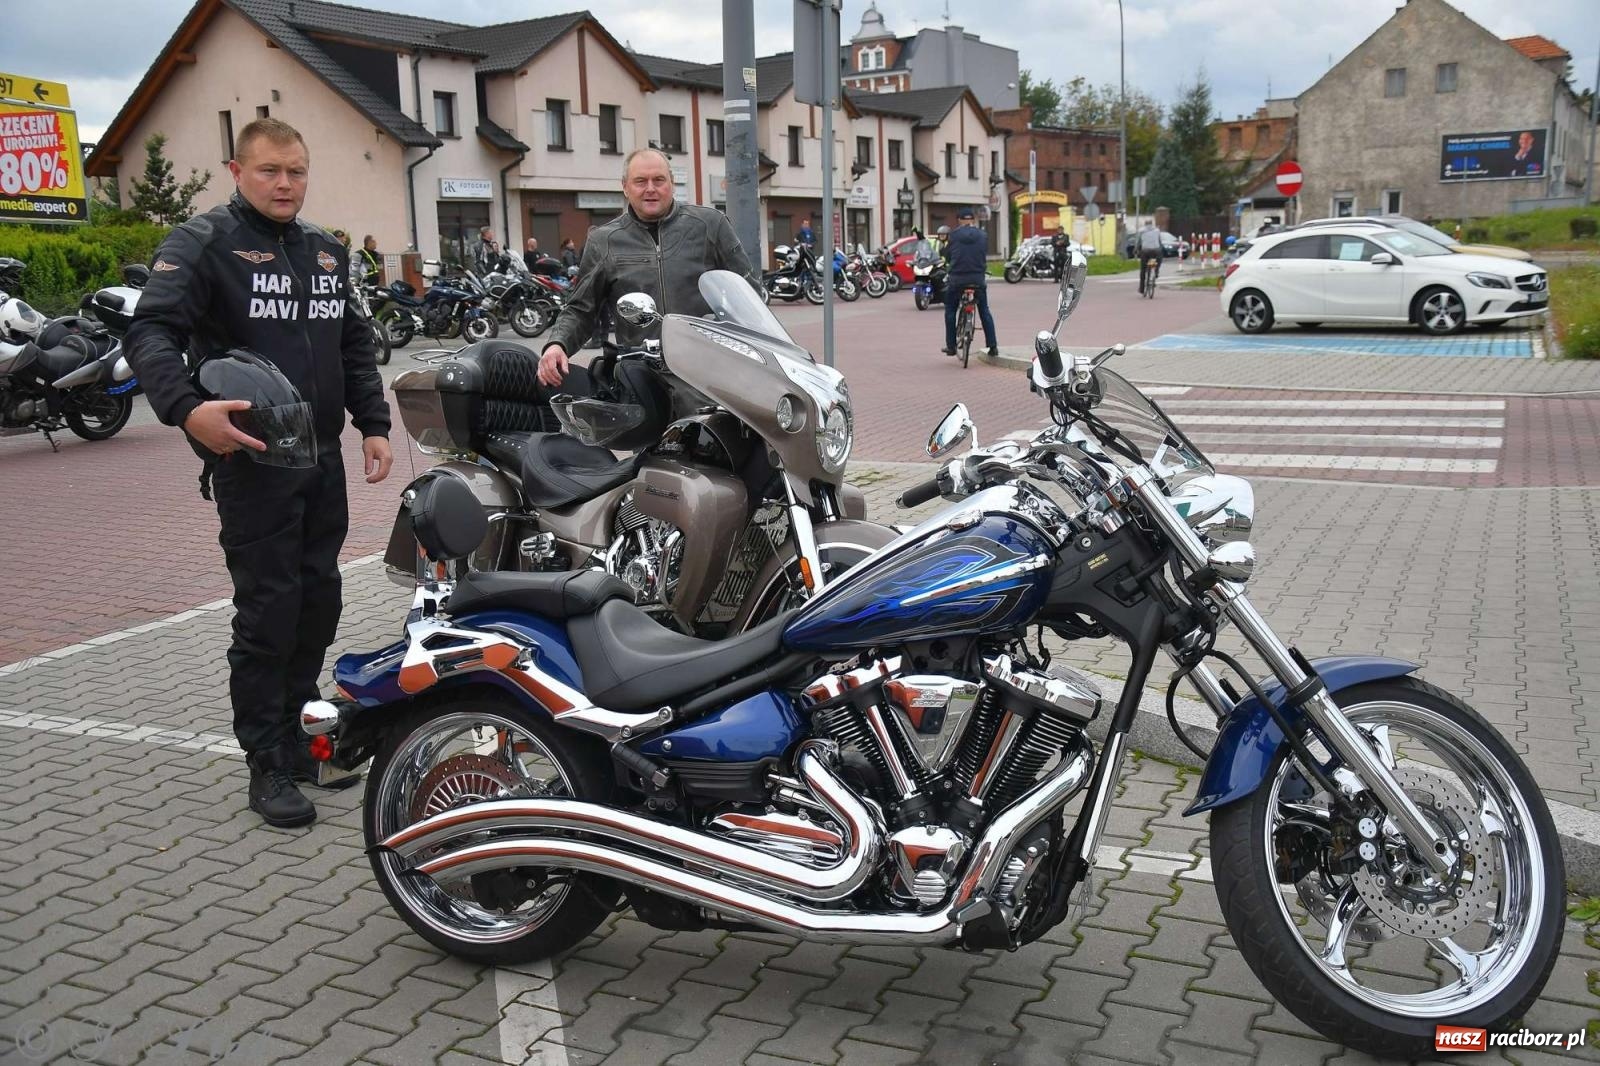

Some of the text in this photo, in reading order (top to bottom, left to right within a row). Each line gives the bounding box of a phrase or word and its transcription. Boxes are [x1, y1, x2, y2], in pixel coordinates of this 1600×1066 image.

[4, 134, 59, 151] URODZINY!
[0, 151, 67, 195] 80%
[0, 199, 68, 216] mediaexpert
